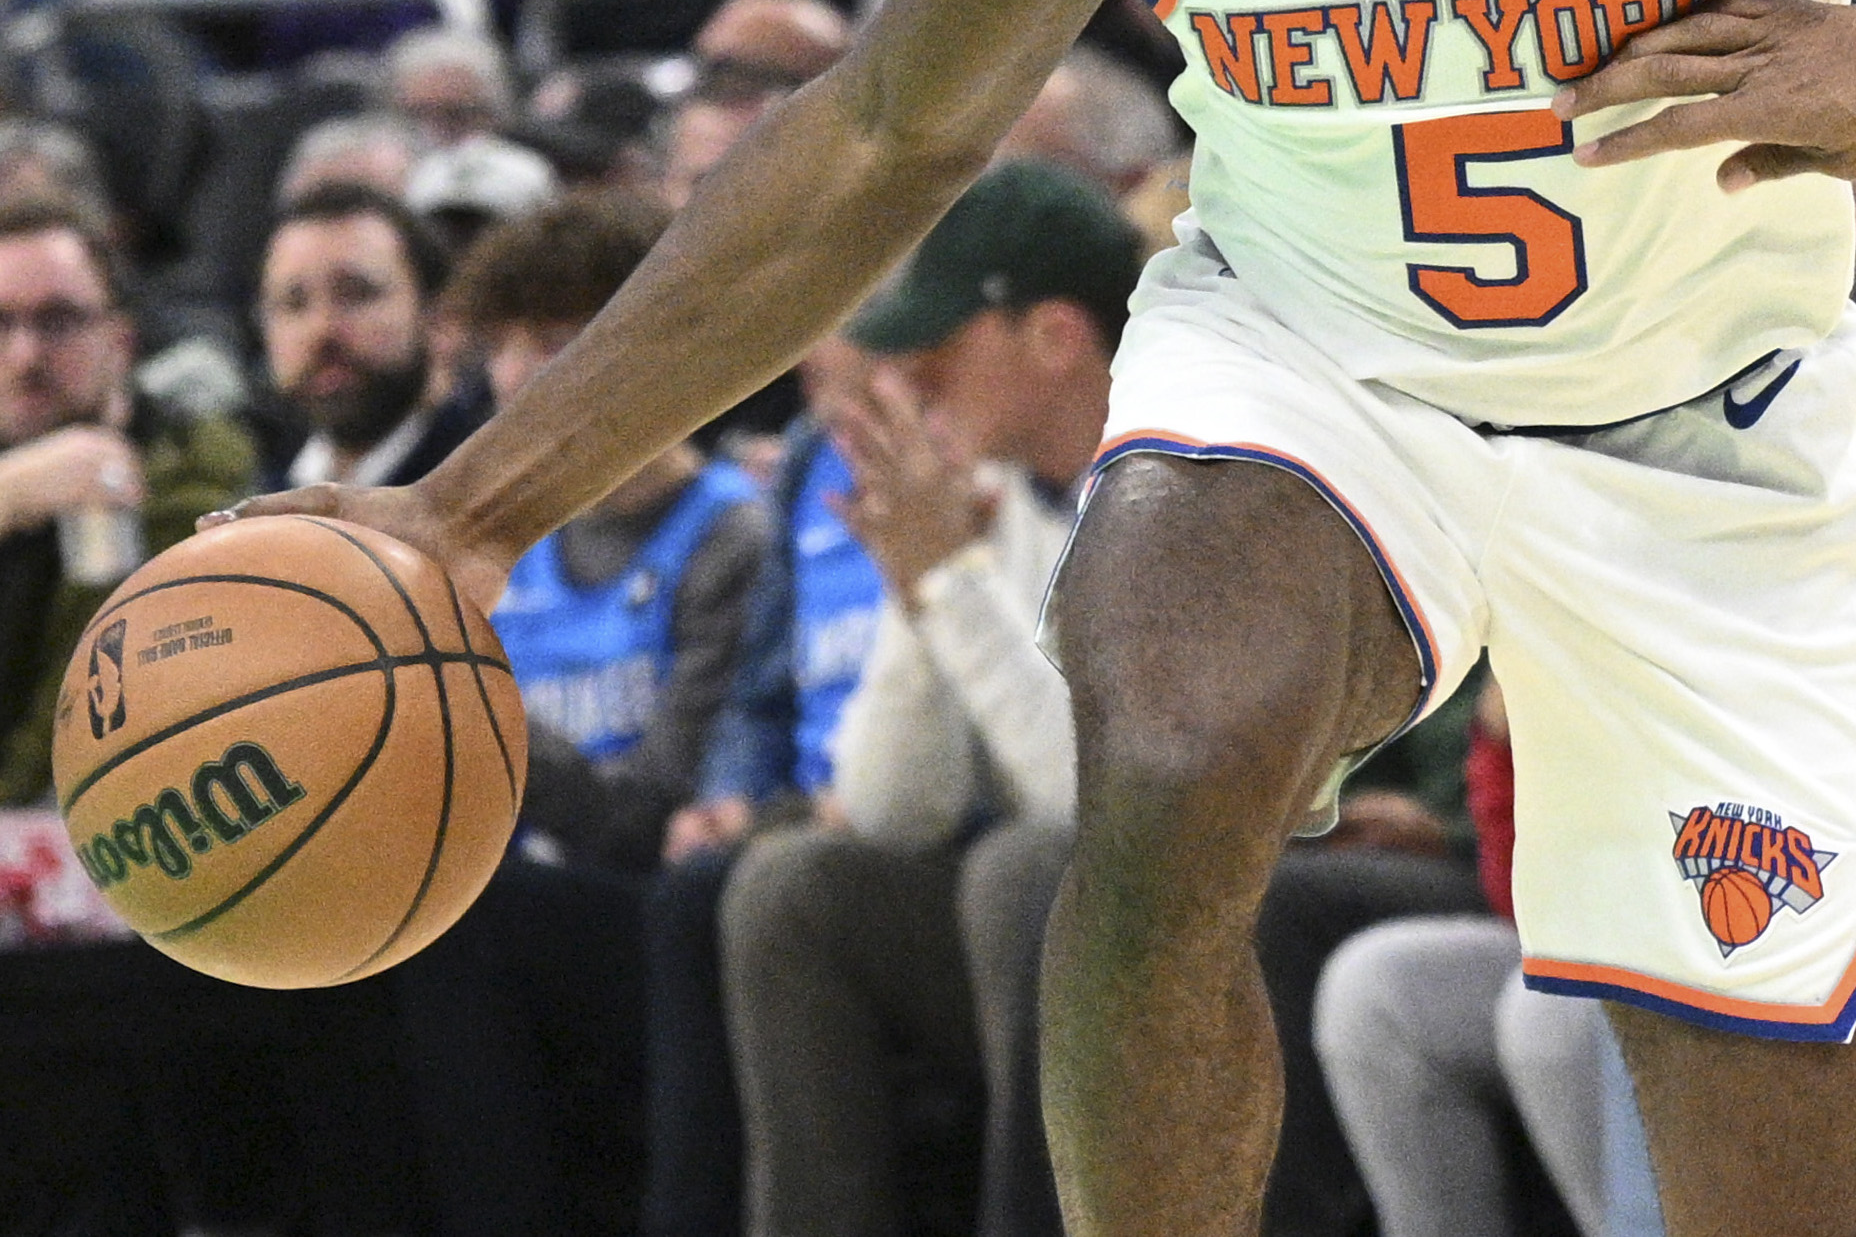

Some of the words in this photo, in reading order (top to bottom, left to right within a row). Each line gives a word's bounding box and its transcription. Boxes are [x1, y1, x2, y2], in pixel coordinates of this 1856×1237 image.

[1390, 106, 1590, 330] 5
[79, 739, 309, 888] Wilson
[1672, 805, 1825, 902] KNICKS
[1714, 801, 1745, 818] NEW
[1747, 804, 1784, 830] YORK
